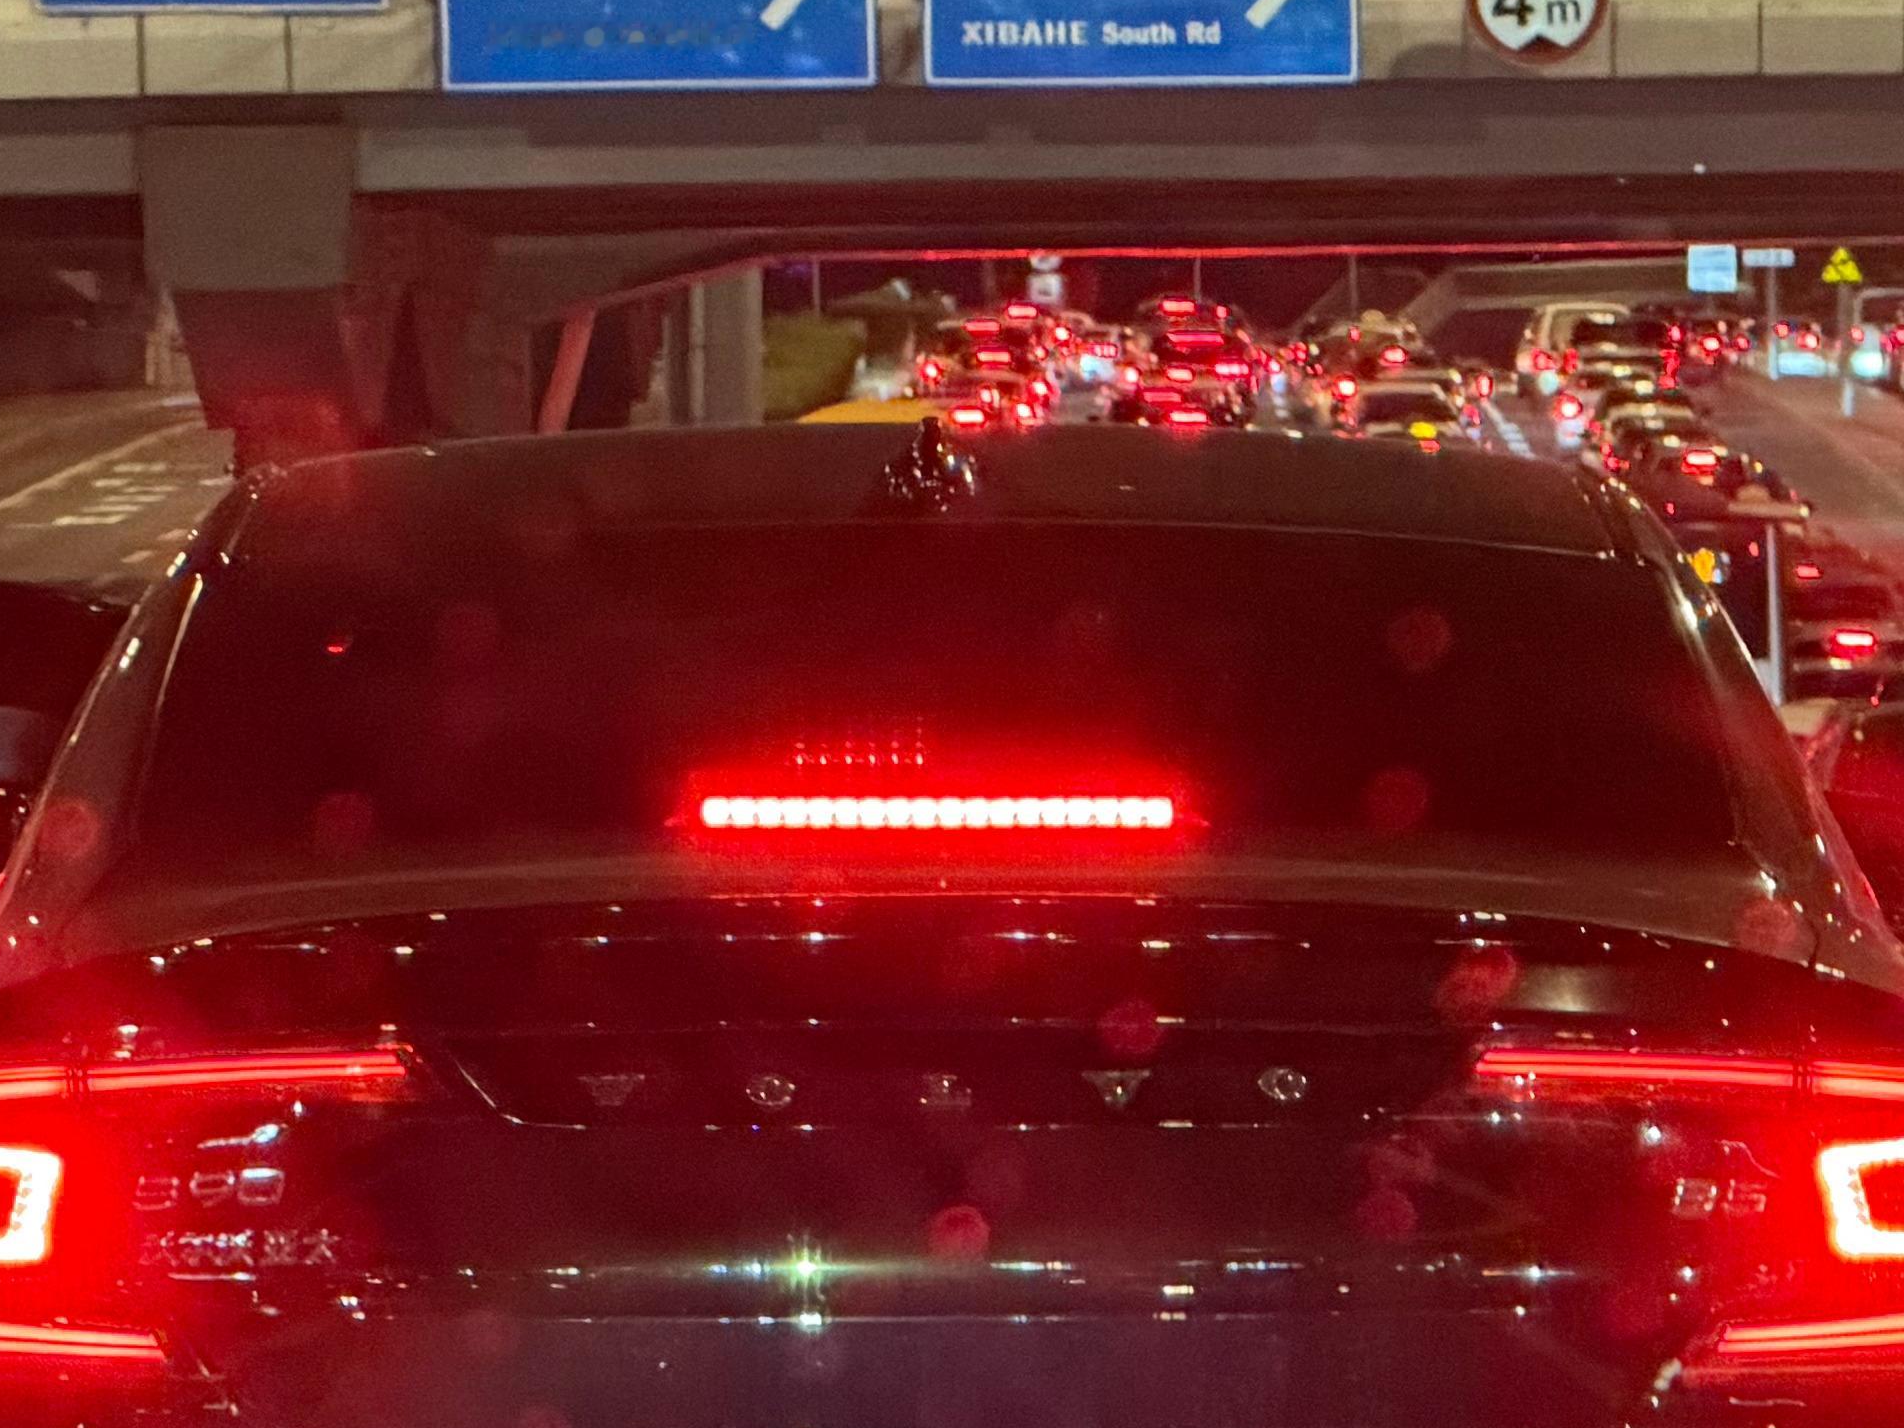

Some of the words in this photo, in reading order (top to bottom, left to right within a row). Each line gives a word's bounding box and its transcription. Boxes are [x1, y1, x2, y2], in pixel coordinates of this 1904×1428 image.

[962, 21, 1087, 46] XIBAHE
[1102, 21, 1176, 45] South
[1186, 21, 1221, 45] Rd
